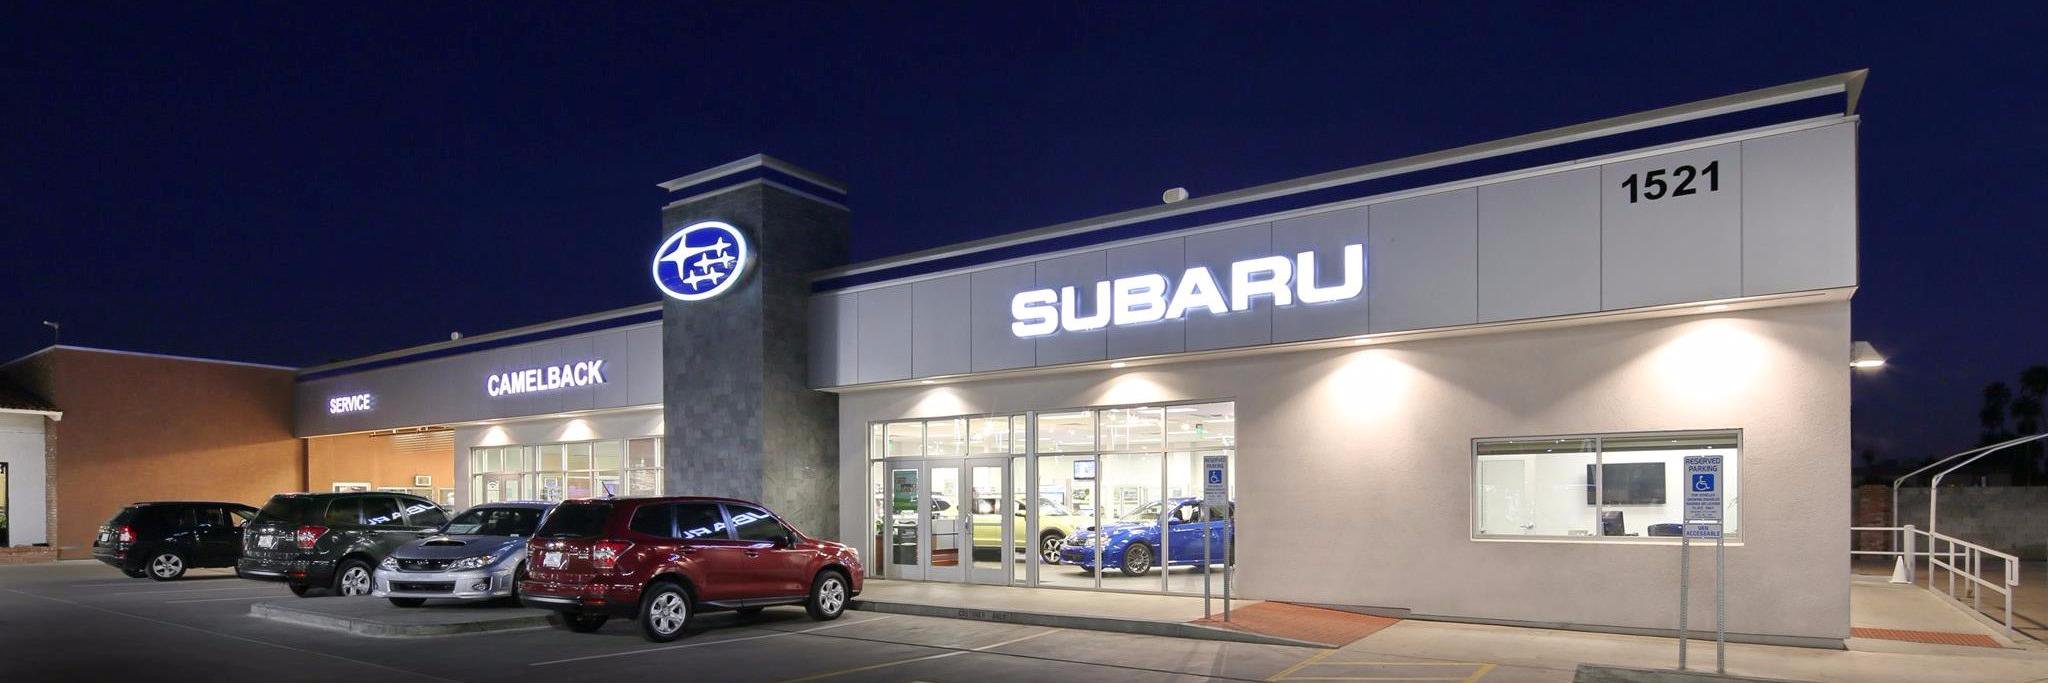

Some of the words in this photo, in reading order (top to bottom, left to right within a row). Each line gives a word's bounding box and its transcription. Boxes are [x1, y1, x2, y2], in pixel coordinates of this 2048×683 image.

[1621, 160, 1719, 203] 1521
[1011, 243, 1365, 338] SUBARU
[487, 359, 604, 397] CAMELBACK
[329, 393, 371, 414] SERVICE
